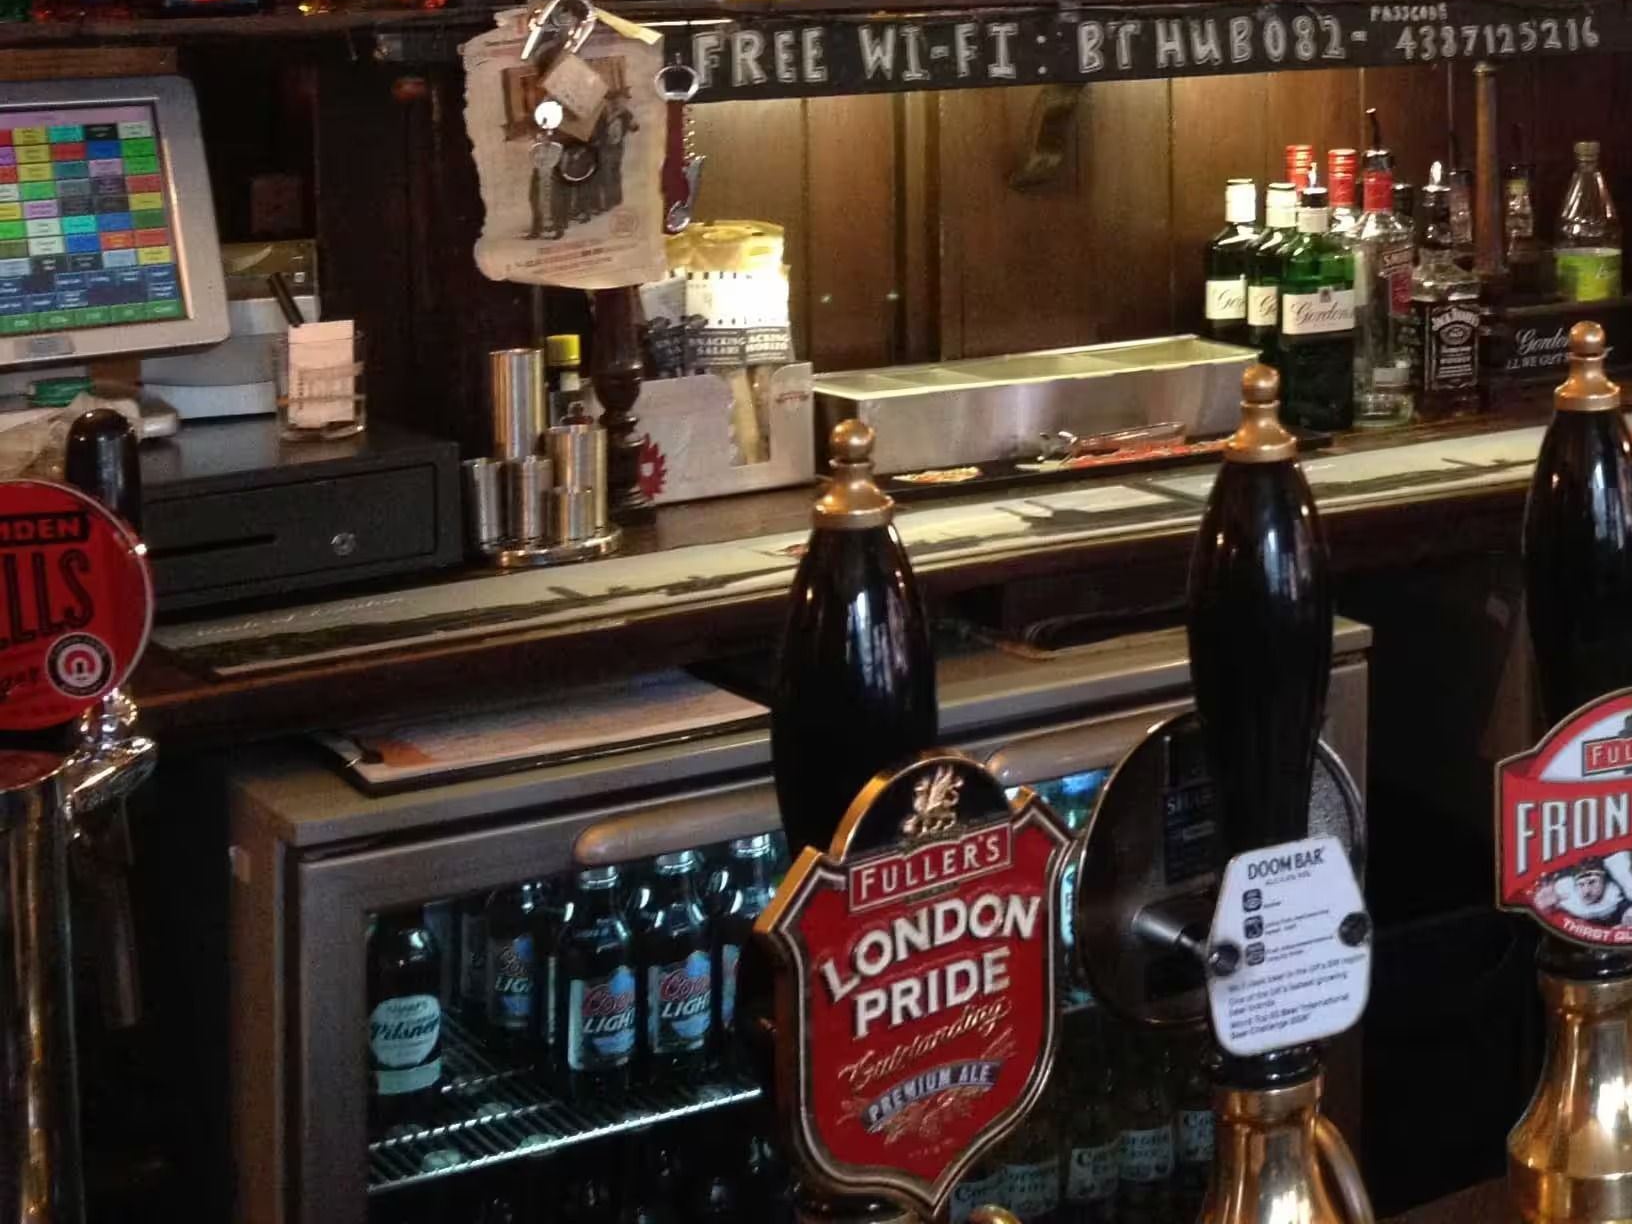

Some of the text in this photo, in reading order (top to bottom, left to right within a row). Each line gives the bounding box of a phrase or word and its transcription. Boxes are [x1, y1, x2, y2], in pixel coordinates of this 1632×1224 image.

[692, 25, 828, 89] FREE
[860, 833, 1001, 901] FULLER'S
[1247, 855, 1292, 881] DOOM
[1295, 846, 1325, 869] BAR
[820, 891, 1042, 1003] LONDON
[853, 946, 1012, 1041] PRIDE
[867, 1062, 993, 1122] PREMIUM ALE
